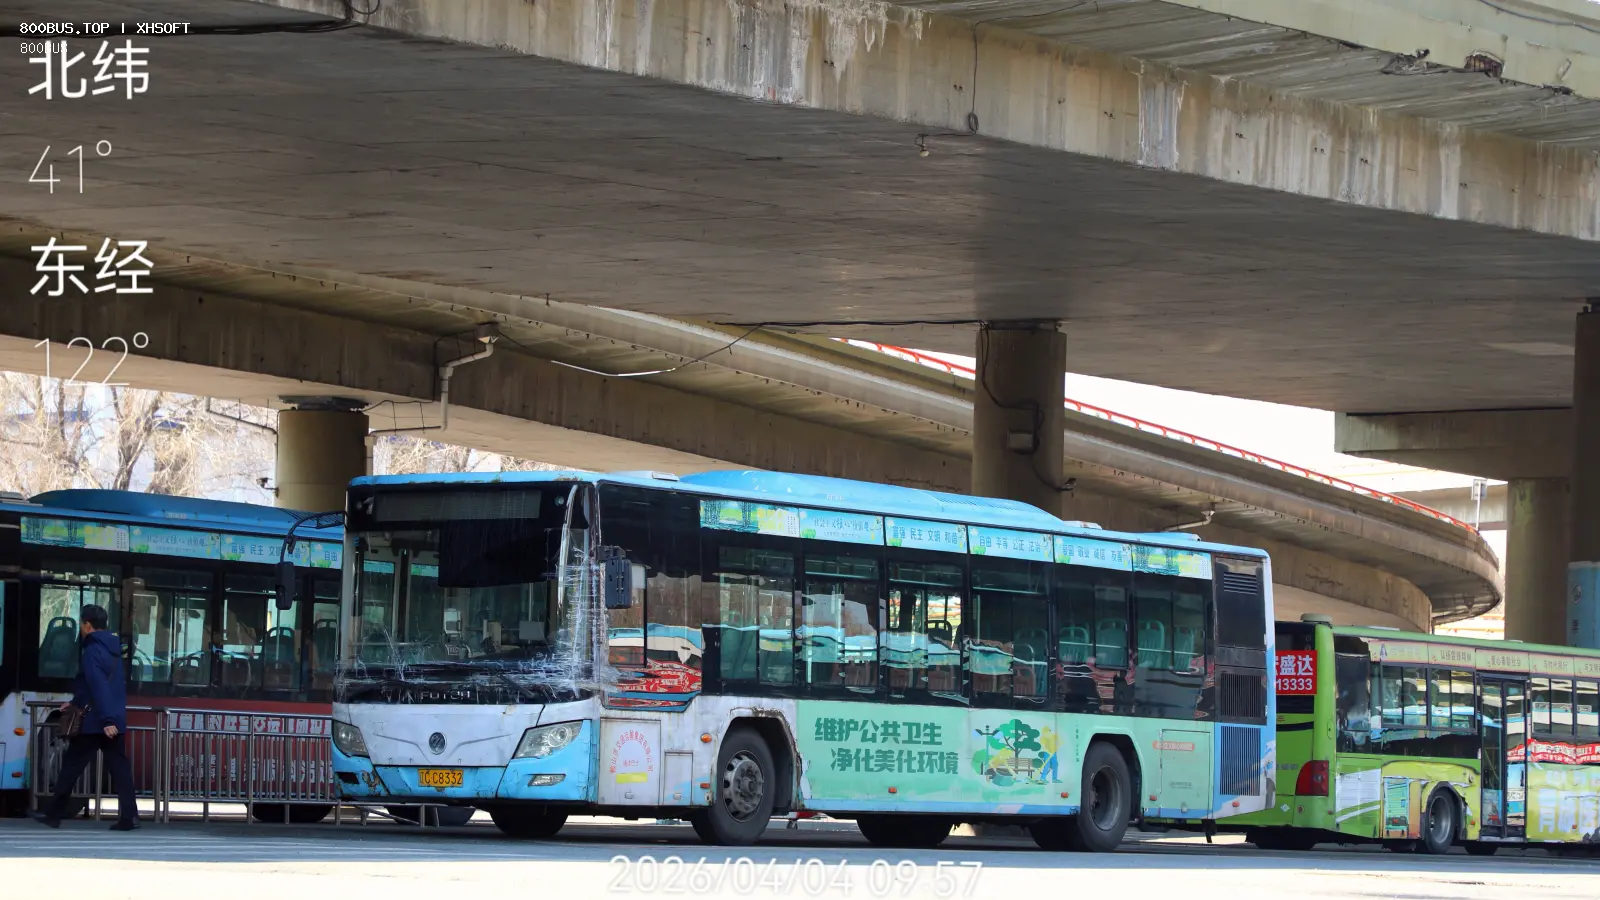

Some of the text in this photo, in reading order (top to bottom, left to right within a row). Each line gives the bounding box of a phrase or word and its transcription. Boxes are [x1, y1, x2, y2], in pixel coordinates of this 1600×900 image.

[892, 525, 958, 544] 富强 民主 文明 和谐
[250, 545, 264, 556] 民主
[979, 535, 992, 548] 自由
[1012, 539, 1024, 551] 公正
[1028, 541, 1041, 553] 法治
[324, 551, 338, 561] 自由
[1093, 548, 1106, 561] 诚信
[1111, 550, 1123, 563] 友善
[814, 717, 943, 746] 维护公共卫生
[830, 747, 959, 775] 净化美化环境
